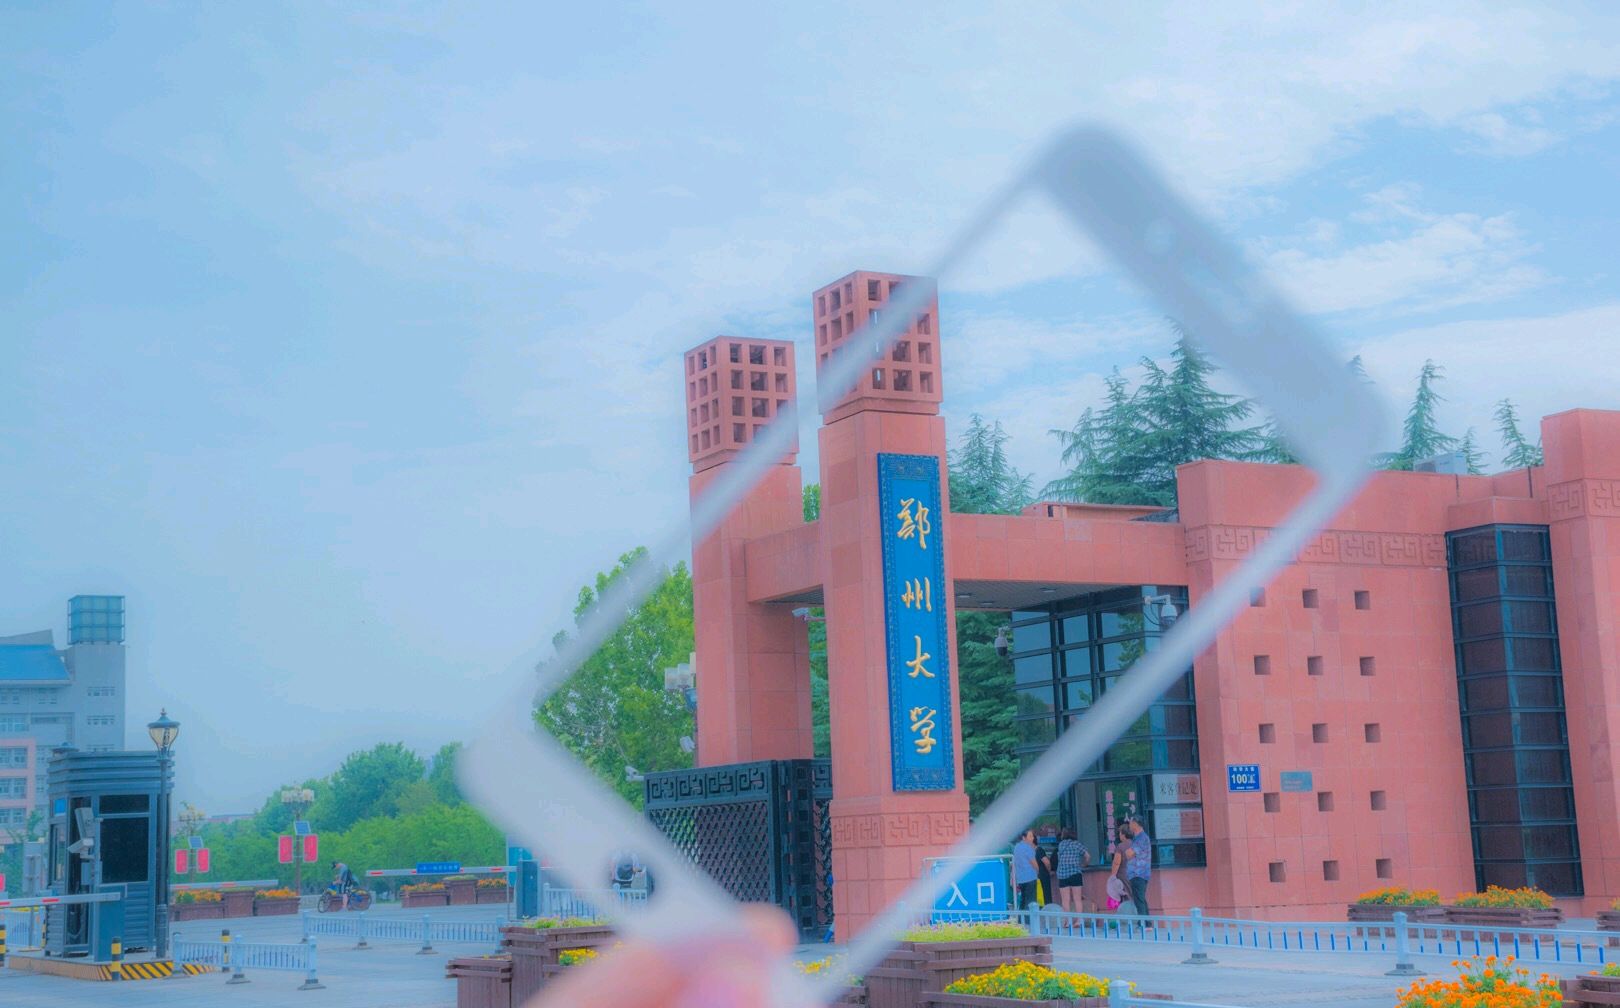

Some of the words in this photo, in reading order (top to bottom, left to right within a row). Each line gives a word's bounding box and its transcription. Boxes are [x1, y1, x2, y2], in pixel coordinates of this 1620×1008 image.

[897, 498, 937, 754] 郑州大学
[946, 881, 995, 907] 入口
